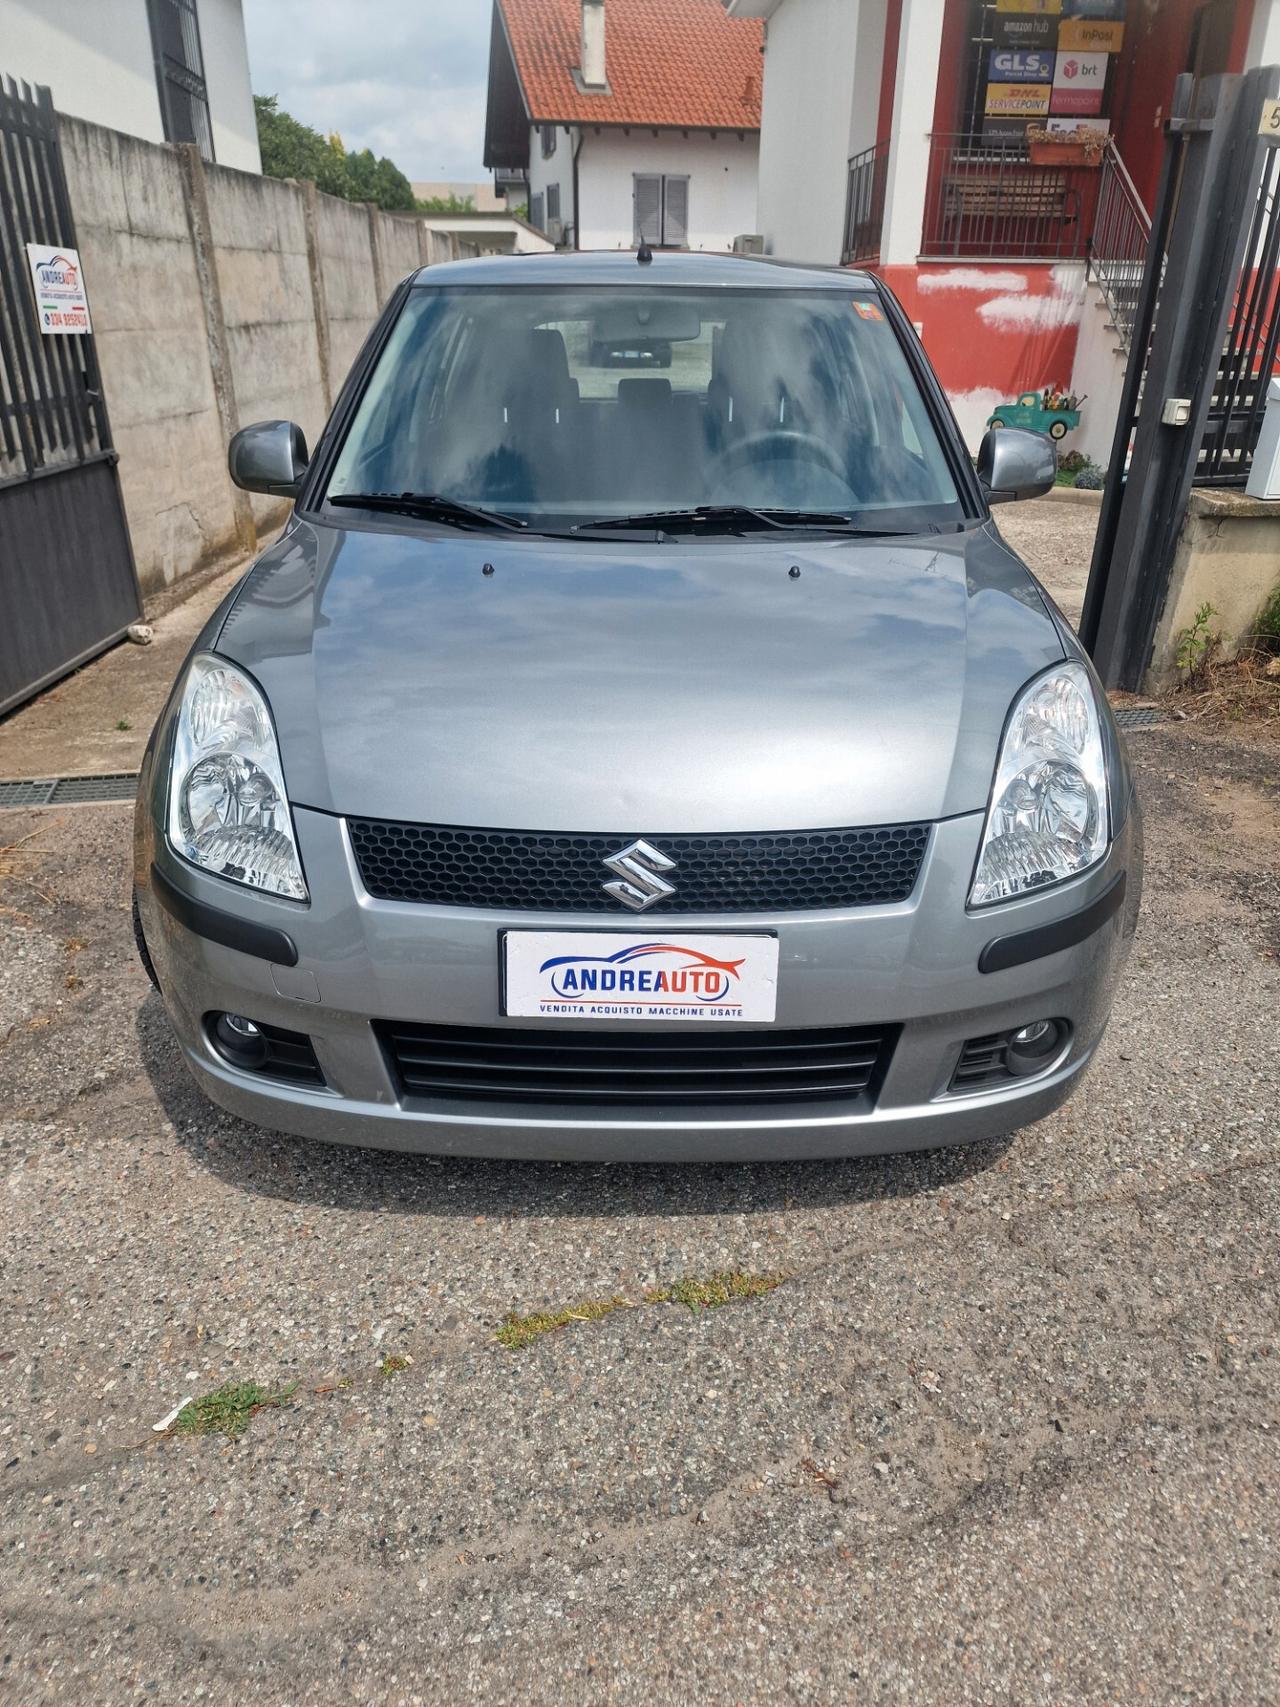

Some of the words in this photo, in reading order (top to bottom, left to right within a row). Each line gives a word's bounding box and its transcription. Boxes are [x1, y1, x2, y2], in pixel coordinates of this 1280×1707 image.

[1003, 22, 1032, 32] amazon
[1033, 17, 1049, 32] hub
[994, 54, 1040, 71] GLS
[1081, 63, 1097, 76] brt
[562, 968, 721, 994] ANDREAUTO
[540, 1005, 585, 1013] VENDITA
[590, 1006, 643, 1015] ACQUISTO
[648, 1007, 705, 1016] MACCHINE
[710, 1009, 743, 1017] USATE
